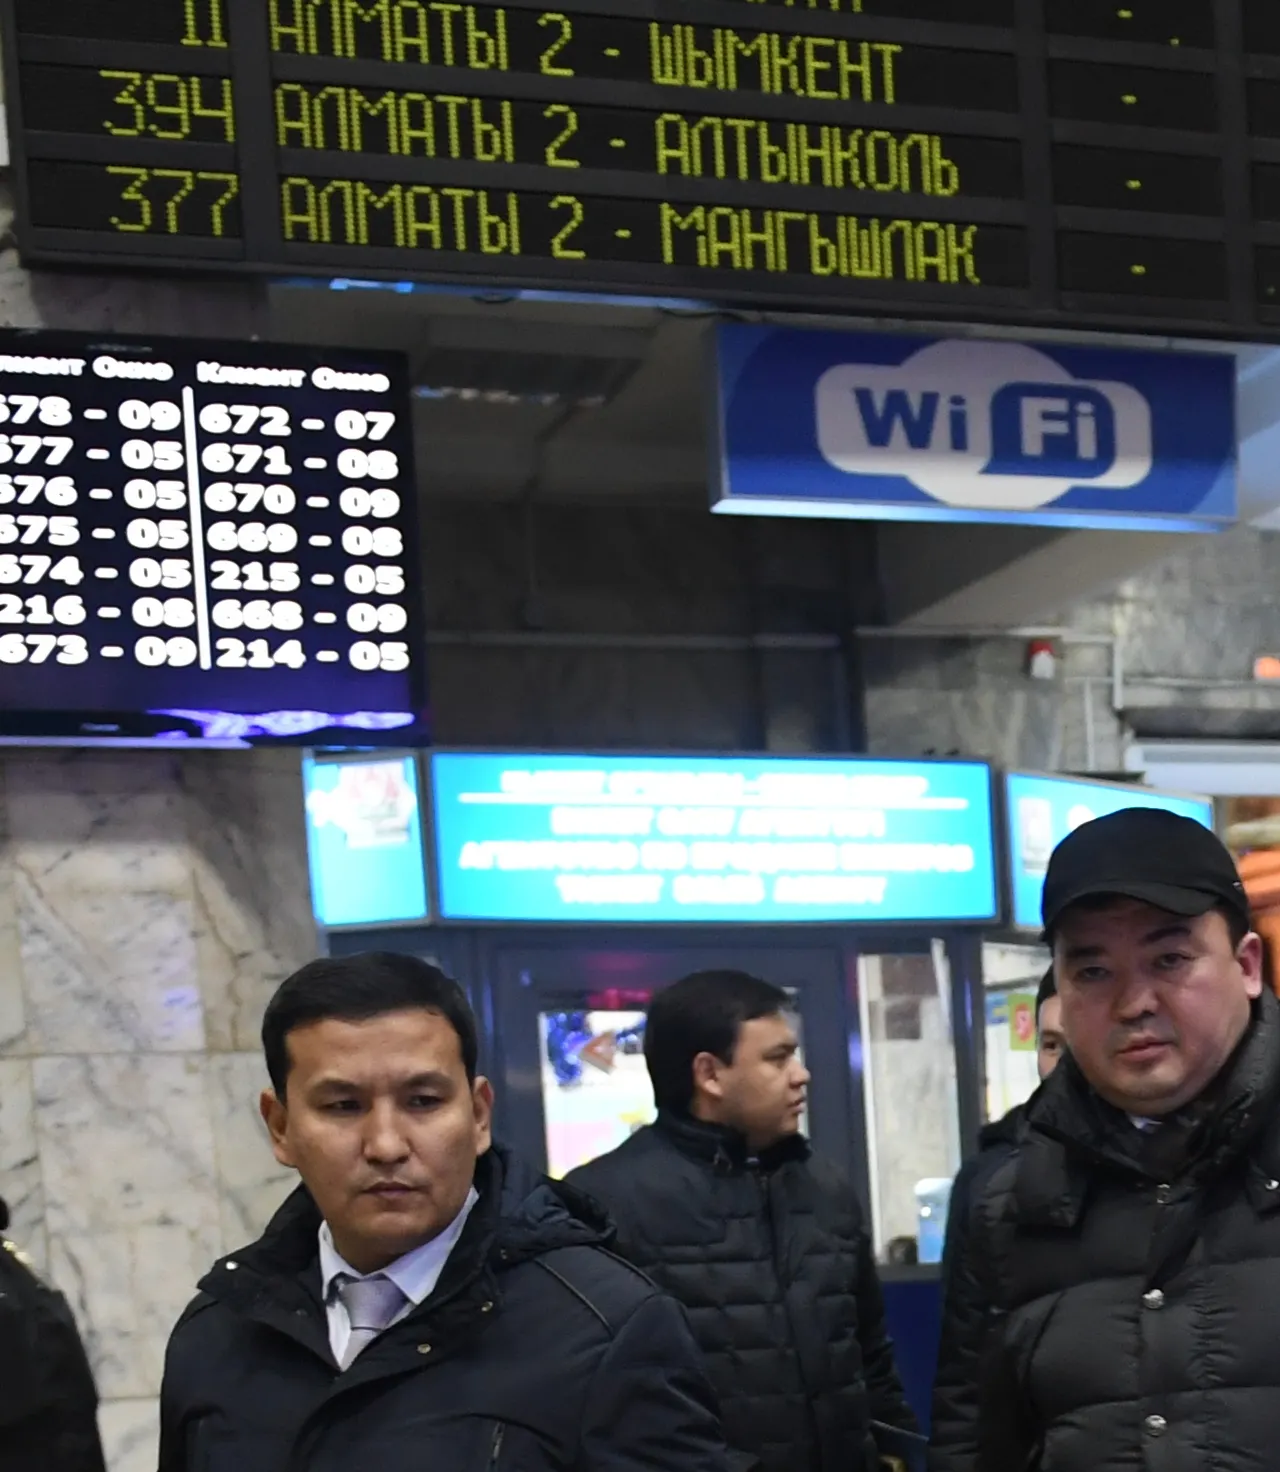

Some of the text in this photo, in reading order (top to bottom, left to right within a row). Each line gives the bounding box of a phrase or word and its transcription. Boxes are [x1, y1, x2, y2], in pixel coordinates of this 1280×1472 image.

[269, 0, 508, 71] АЛМАТЫ
[538, 12, 574, 77] 2
[649, 22, 902, 105] ШЫМКЕНТ
[99, 70, 235, 143] 394
[275, 82, 514, 163] АЛМАТЫ
[544, 104, 578, 168] 2
[655, 113, 959, 197] АЛТЫНКОЛЬ
[106, 165, 239, 236] 377
[281, 177, 521, 255] АЛМАТЫ
[550, 195, 586, 259] 2
[660, 202, 981, 284] МАНГЫШЛАК
[119, 400, 181, 430] 09
[200, 404, 291, 436] 672
[335, 410, 395, 440] 07
[853, 387, 1098, 459] Wi Fi
[121, 440, 184, 470] 05
[202, 443, 292, 474] 671
[338, 449, 398, 479] 08
[124, 479, 186, 509] 05
[205, 482, 295, 514] 670
[340, 488, 400, 517] 09
[127, 519, 189, 549] 05
[207, 522, 297, 552] 669
[342, 526, 403, 556] 08
[0, 554, 84, 585] 674
[130, 558, 191, 588] 05
[211, 560, 300, 591] 215
[345, 565, 404, 594] 05
[0, 594, 86, 625] 216
[132, 597, 195, 627] 08
[212, 599, 303, 630] 668
[347, 603, 406, 632] 09
[0, 634, 88, 664] 673
[135, 636, 197, 666] 09
[216, 638, 306, 668] 214
[349, 641, 409, 671] 05
